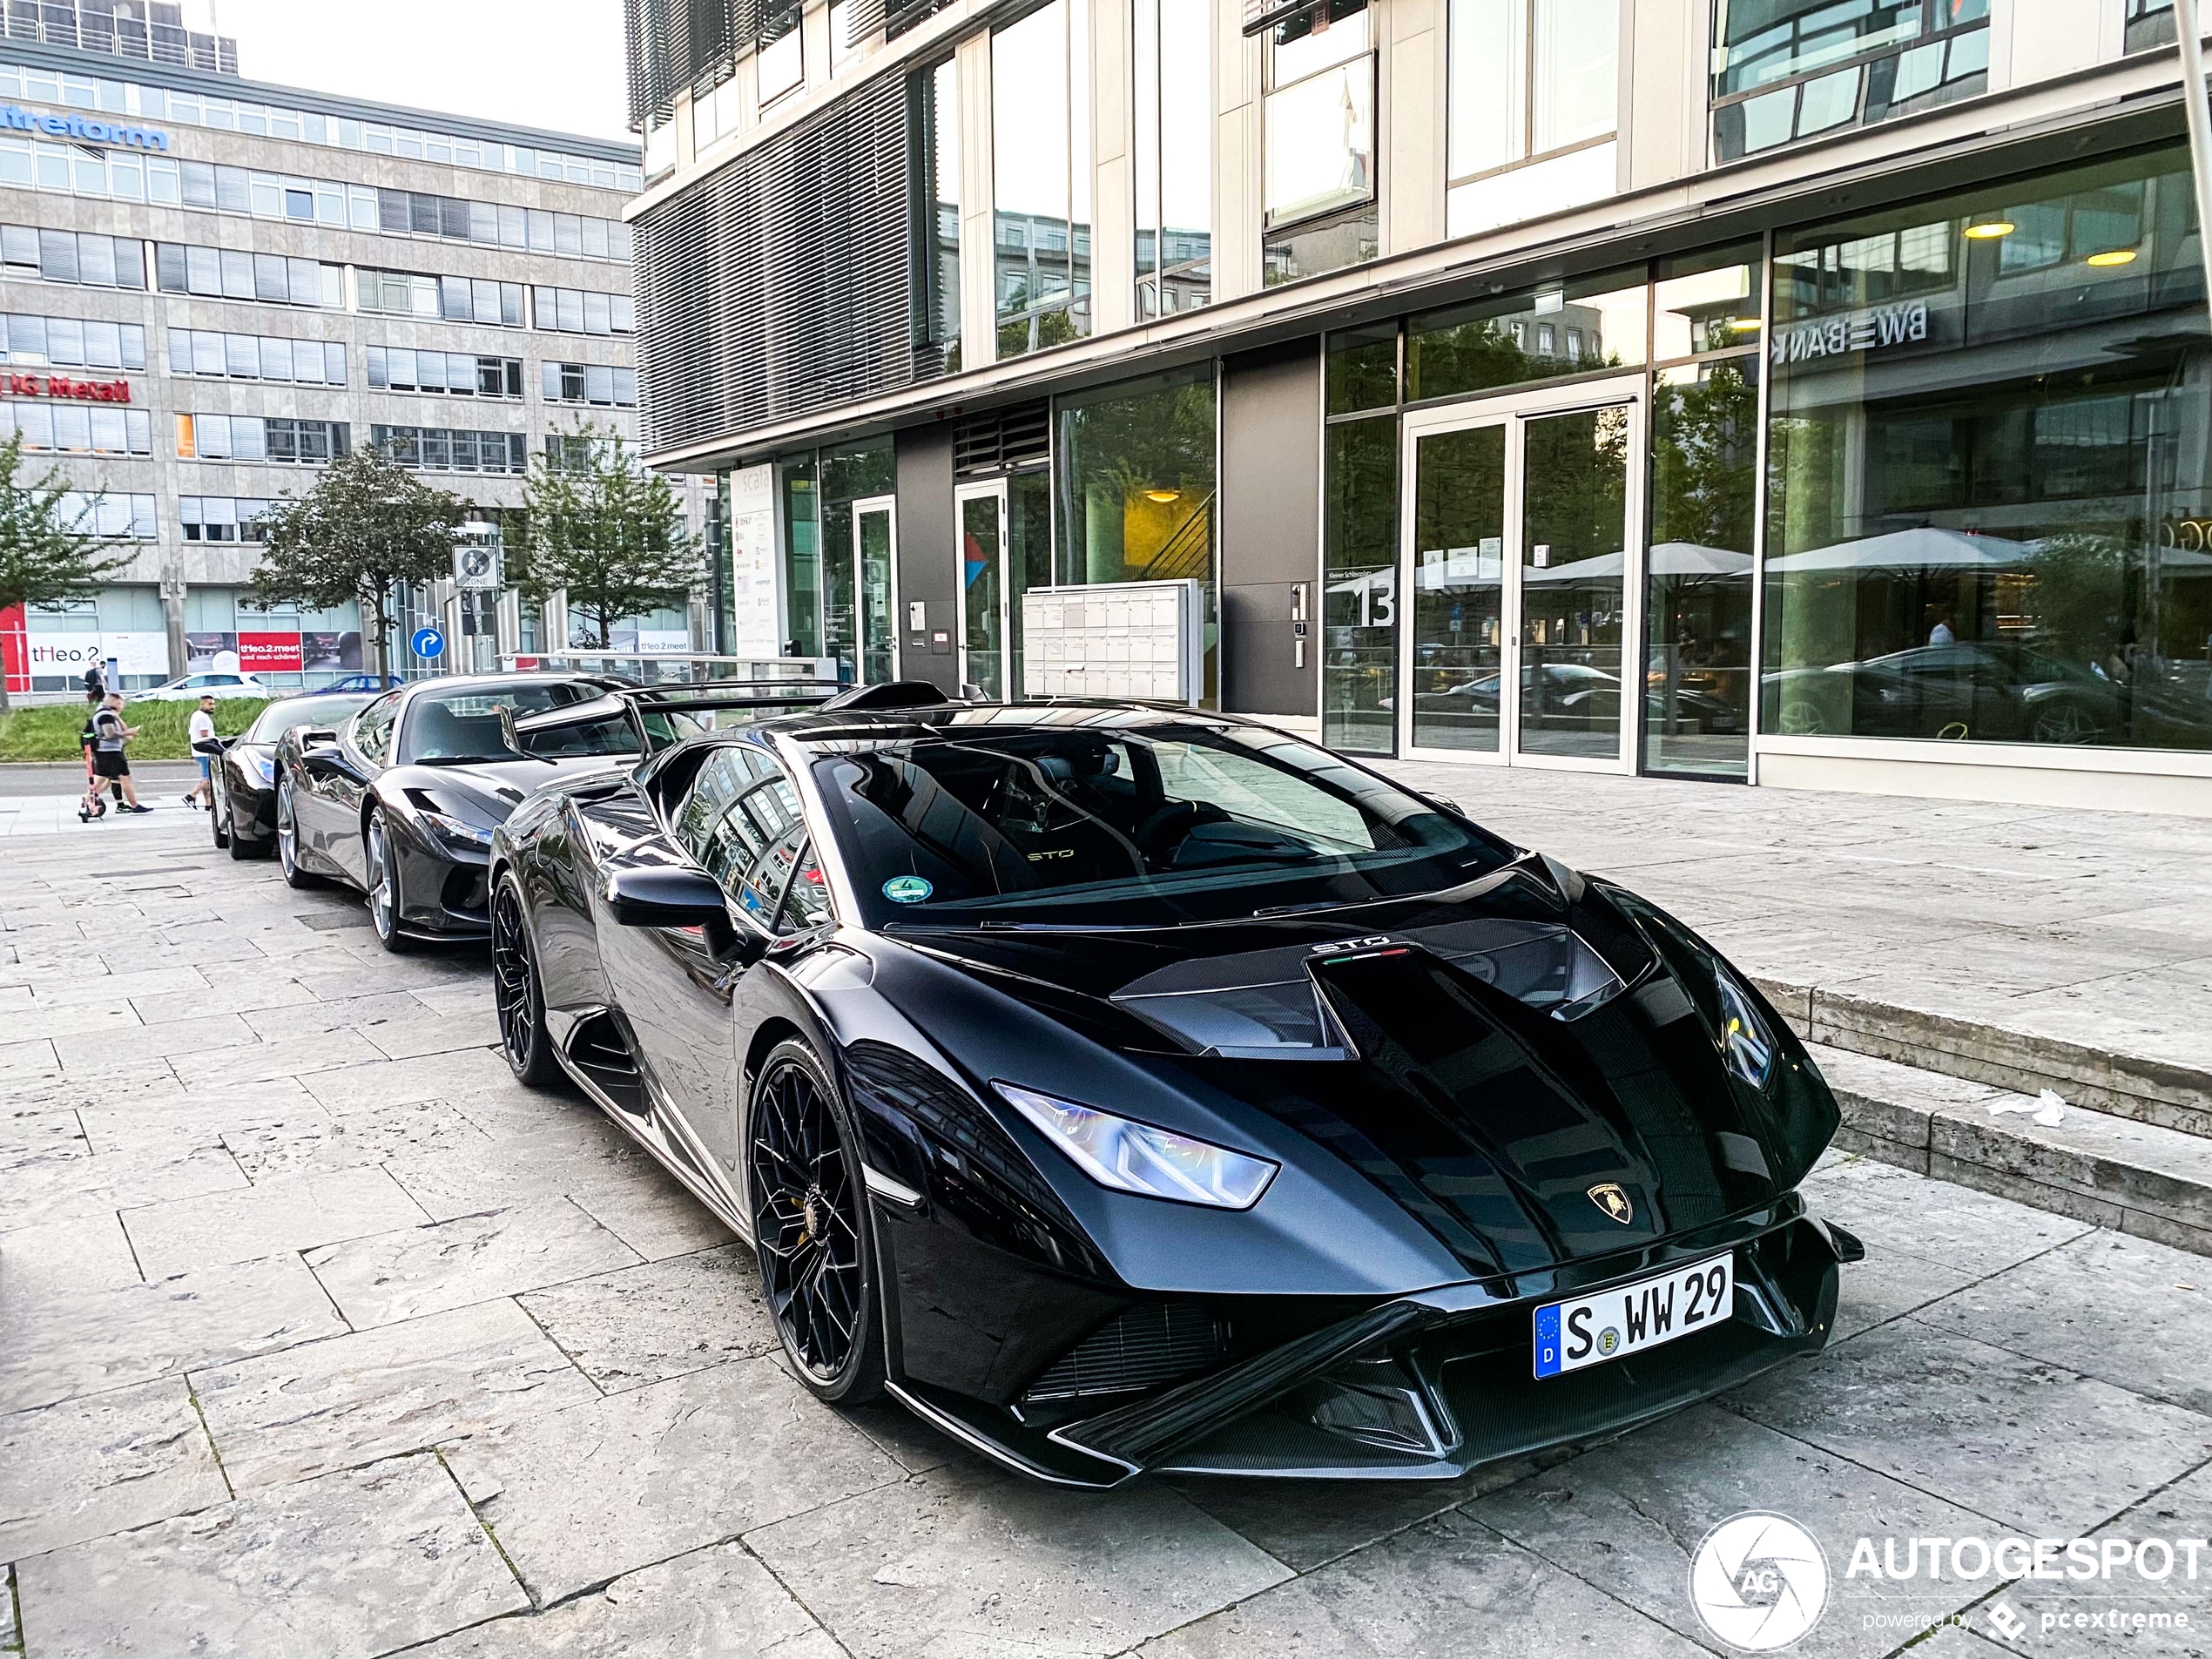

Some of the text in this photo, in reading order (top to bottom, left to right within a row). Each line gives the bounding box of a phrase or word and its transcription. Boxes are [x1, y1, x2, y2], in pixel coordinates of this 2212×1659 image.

[11, 373, 131, 403] IG Metall
[743, 466, 770, 492] scala
[1353, 579, 1395, 627] 13
[1028, 849, 1074, 860] STO
[901, 880, 914, 889] 4
[1312, 936, 1390, 953] STO
[1567, 1264, 1726, 1359] S WW 29
[1543, 1347, 1554, 1363] D
